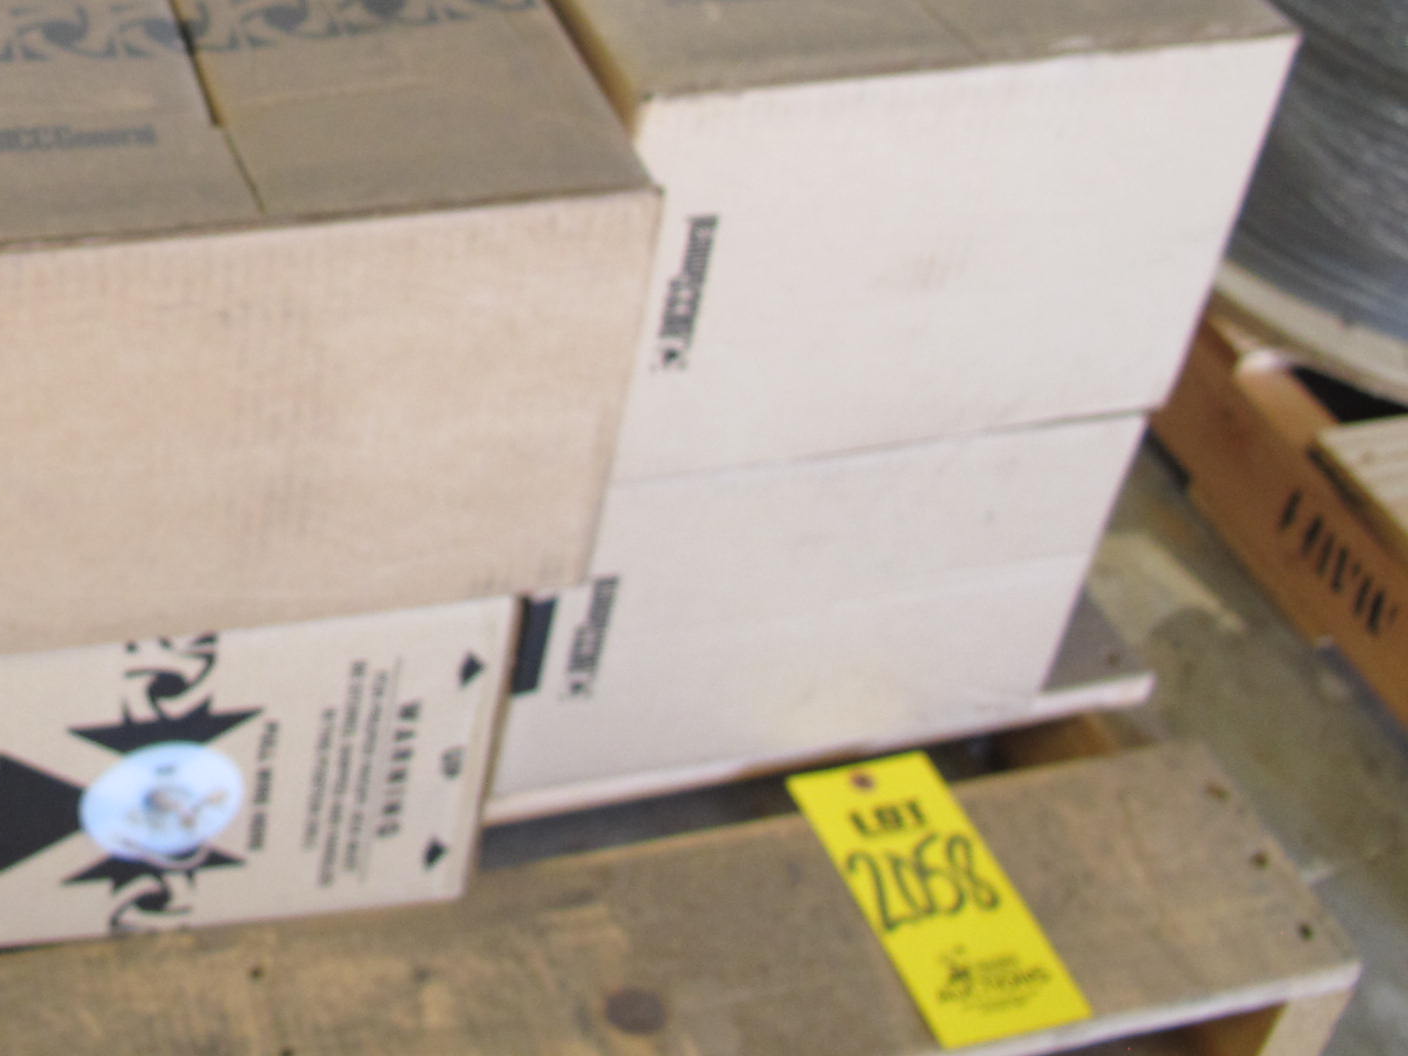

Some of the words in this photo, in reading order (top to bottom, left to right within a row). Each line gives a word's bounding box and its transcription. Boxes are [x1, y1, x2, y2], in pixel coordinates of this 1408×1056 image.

[375, 700, 421, 838] WARNING
[849, 800, 926, 836] LOT
[846, 833, 1000, 932] 2058
